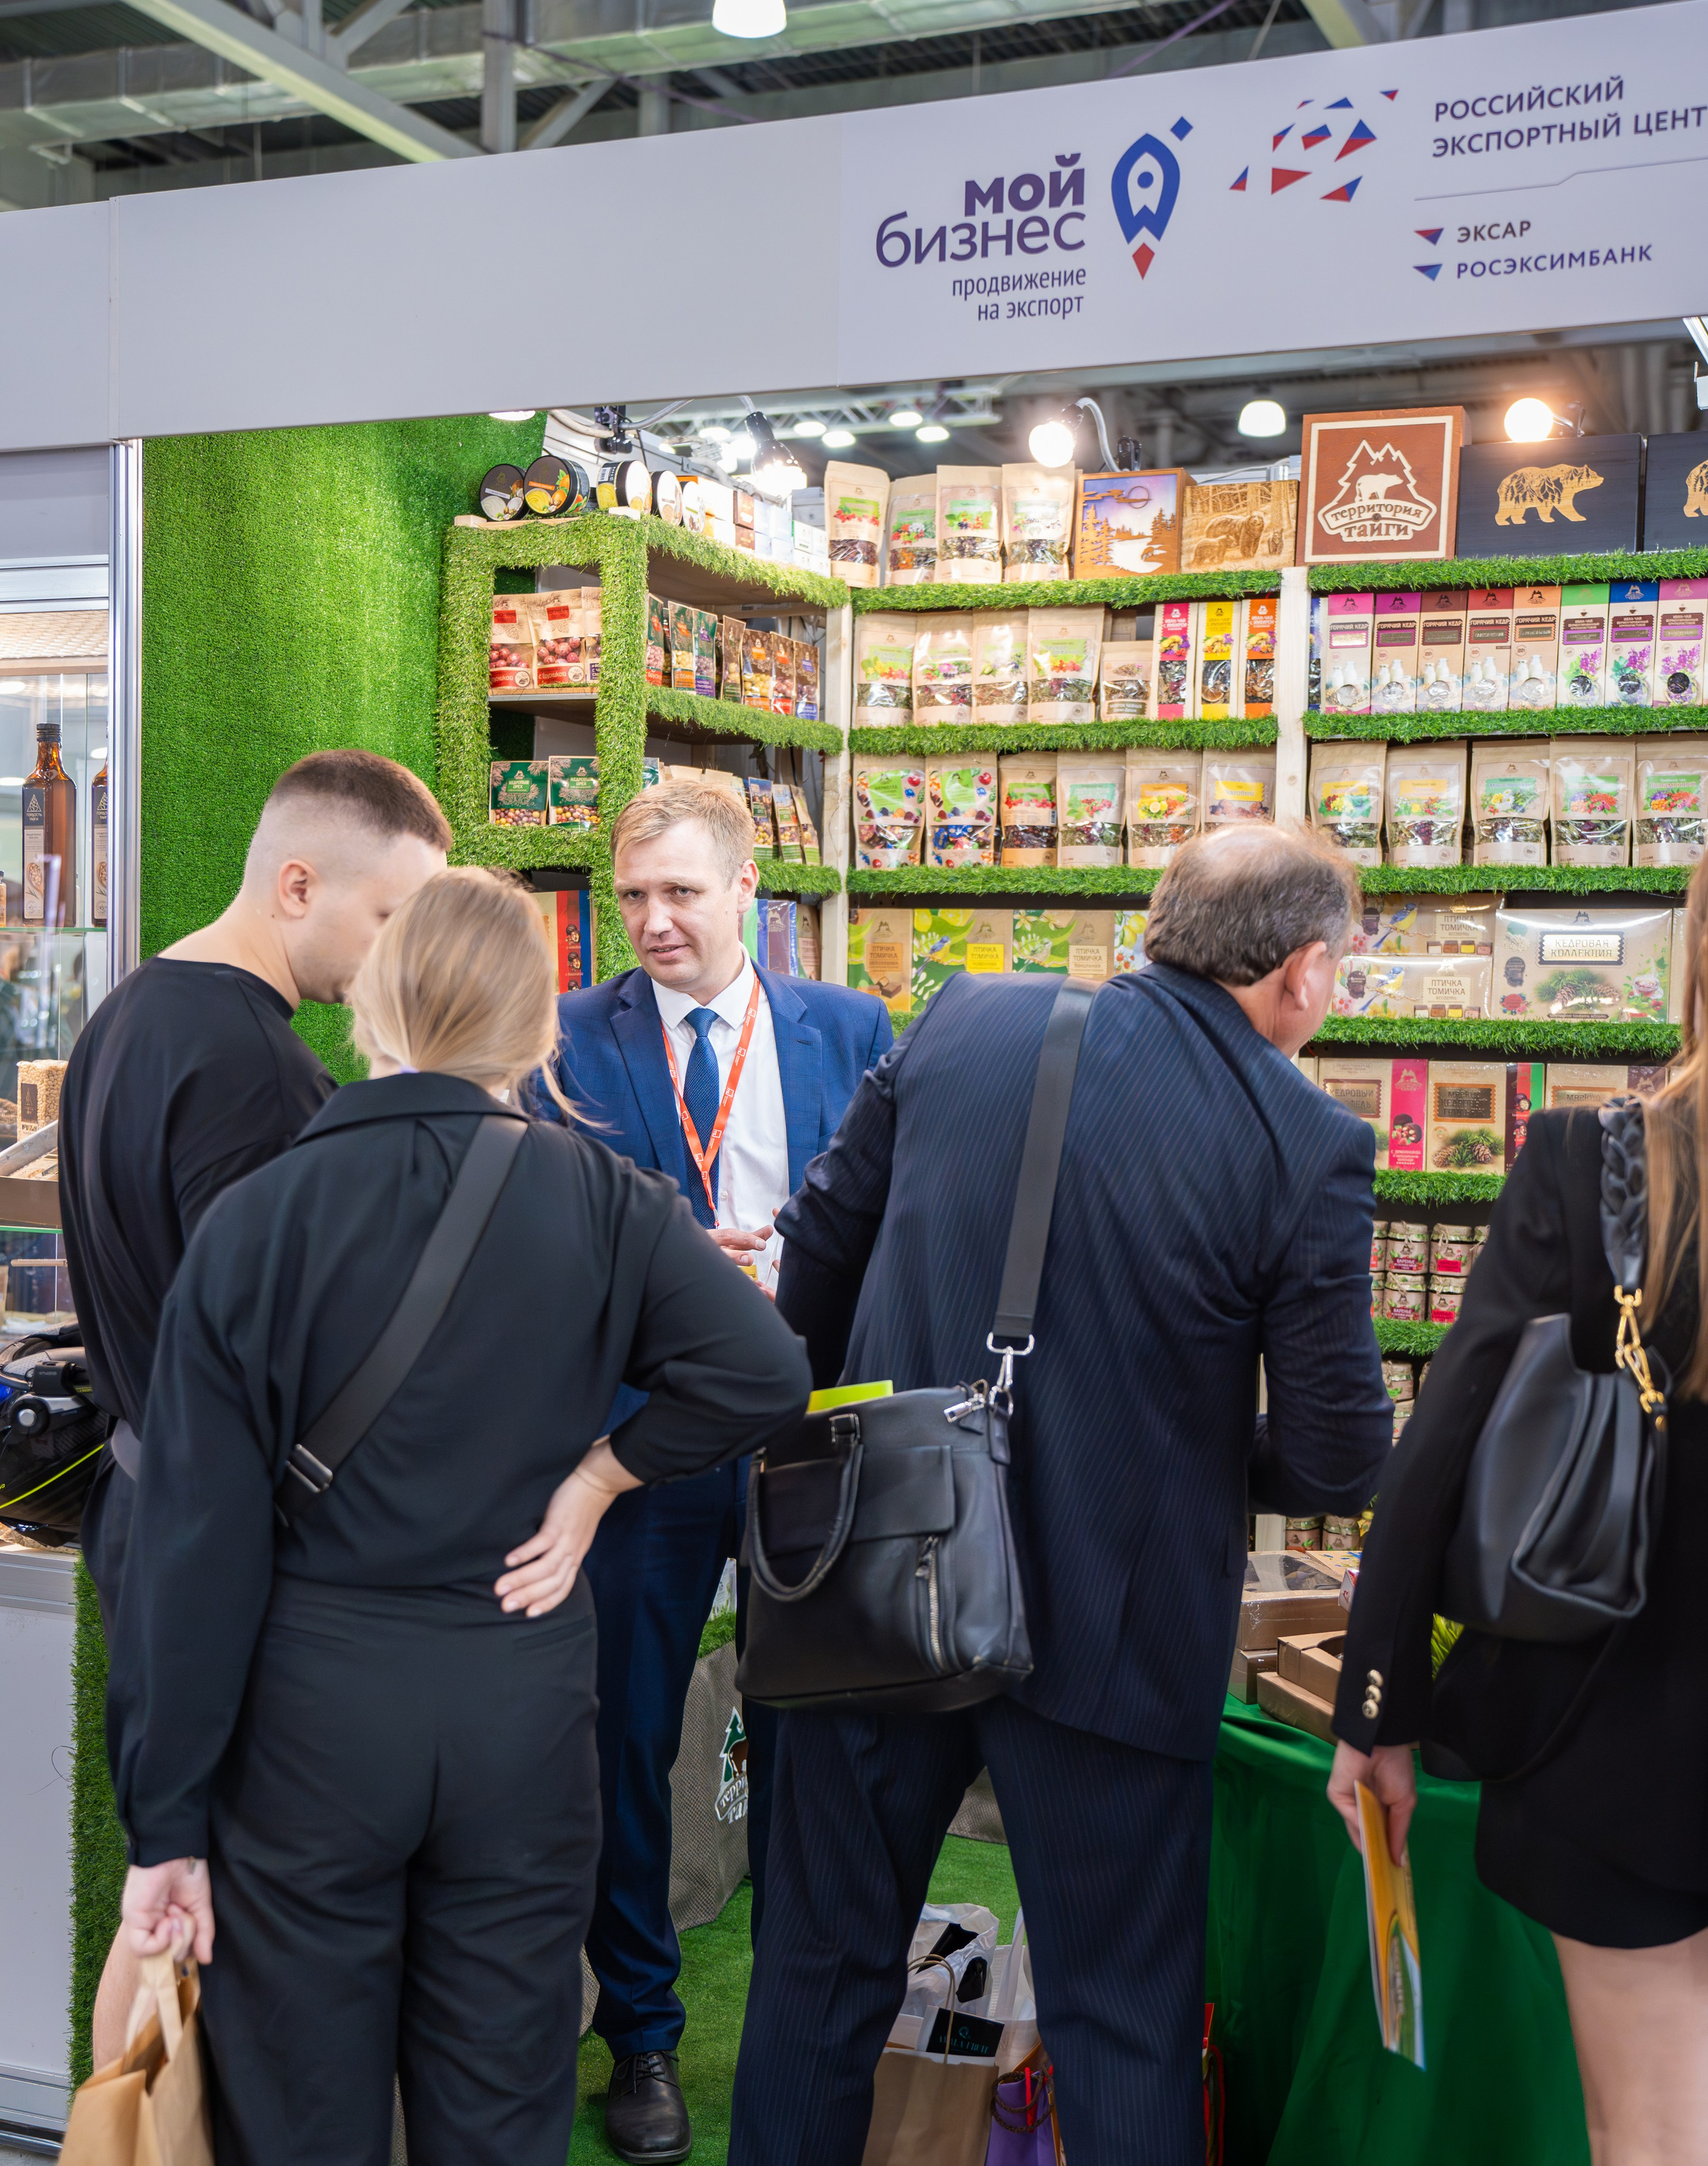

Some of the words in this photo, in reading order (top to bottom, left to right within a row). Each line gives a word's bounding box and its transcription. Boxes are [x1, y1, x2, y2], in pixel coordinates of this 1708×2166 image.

[1435, 75, 1624, 122] РОССИЙСКИЙ
[1432, 113, 1621, 157] ЭКСПОРТНЫЙ
[1634, 106, 1708, 137] ЦЕНТ
[964, 153, 1085, 217] мой
[876, 211, 1086, 268] бизнес
[1457, 221, 1531, 243] ЭКСАР
[1457, 244, 1653, 279] РОСЭКСИМБАНК
[952, 268, 1086, 301] продвижение
[978, 302, 999, 321] на
[1006, 295, 1084, 319] экспорт
[1331, 504, 1423, 521] территория
[1551, 949, 1613, 957] КОЛЛЕКЦИЯ
[1555, 939, 1609, 948] КЕДРОВАЯ
[720, 1776, 748, 1808] терри
